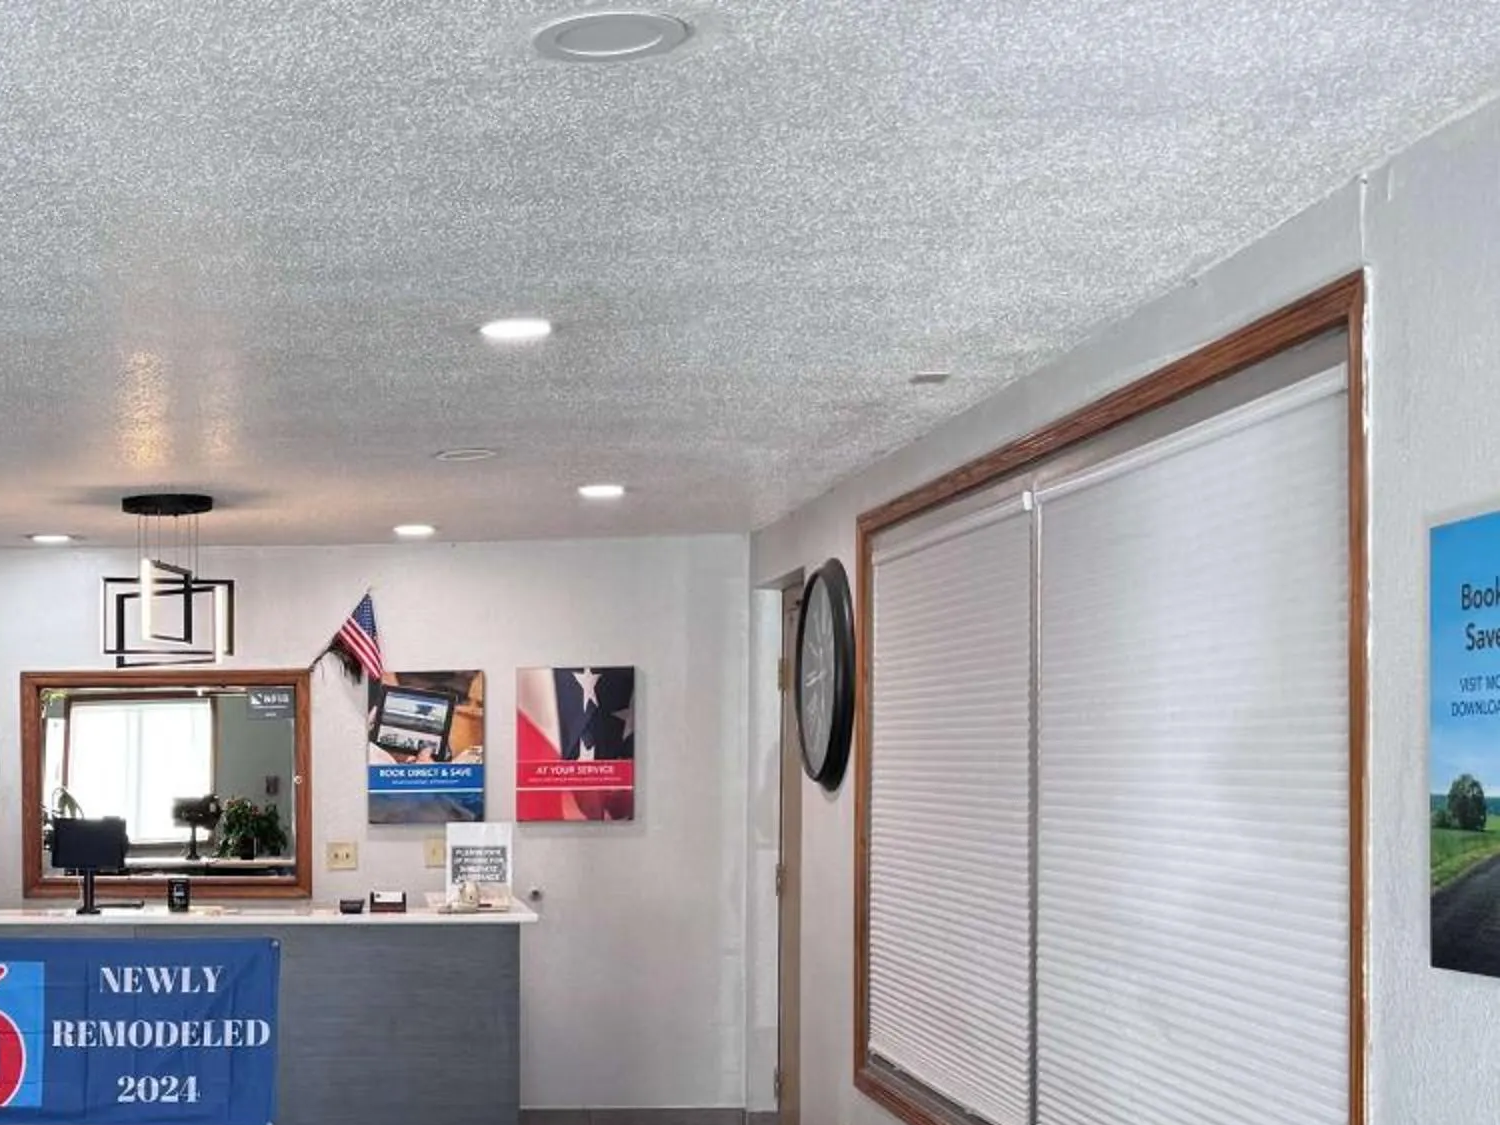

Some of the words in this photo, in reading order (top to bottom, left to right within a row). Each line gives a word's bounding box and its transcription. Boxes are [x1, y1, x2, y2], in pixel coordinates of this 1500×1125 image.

[380, 768, 405, 778] BOOK
[407, 767, 439, 777] DIRECT
[535, 765, 548, 775] AT
[551, 764, 575, 775] YOUR
[577, 764, 614, 775] SERVICE
[99, 965, 224, 993] NEWLY
[51, 1018, 271, 1048] REMODELED
[116, 1075, 201, 1104] 2024
